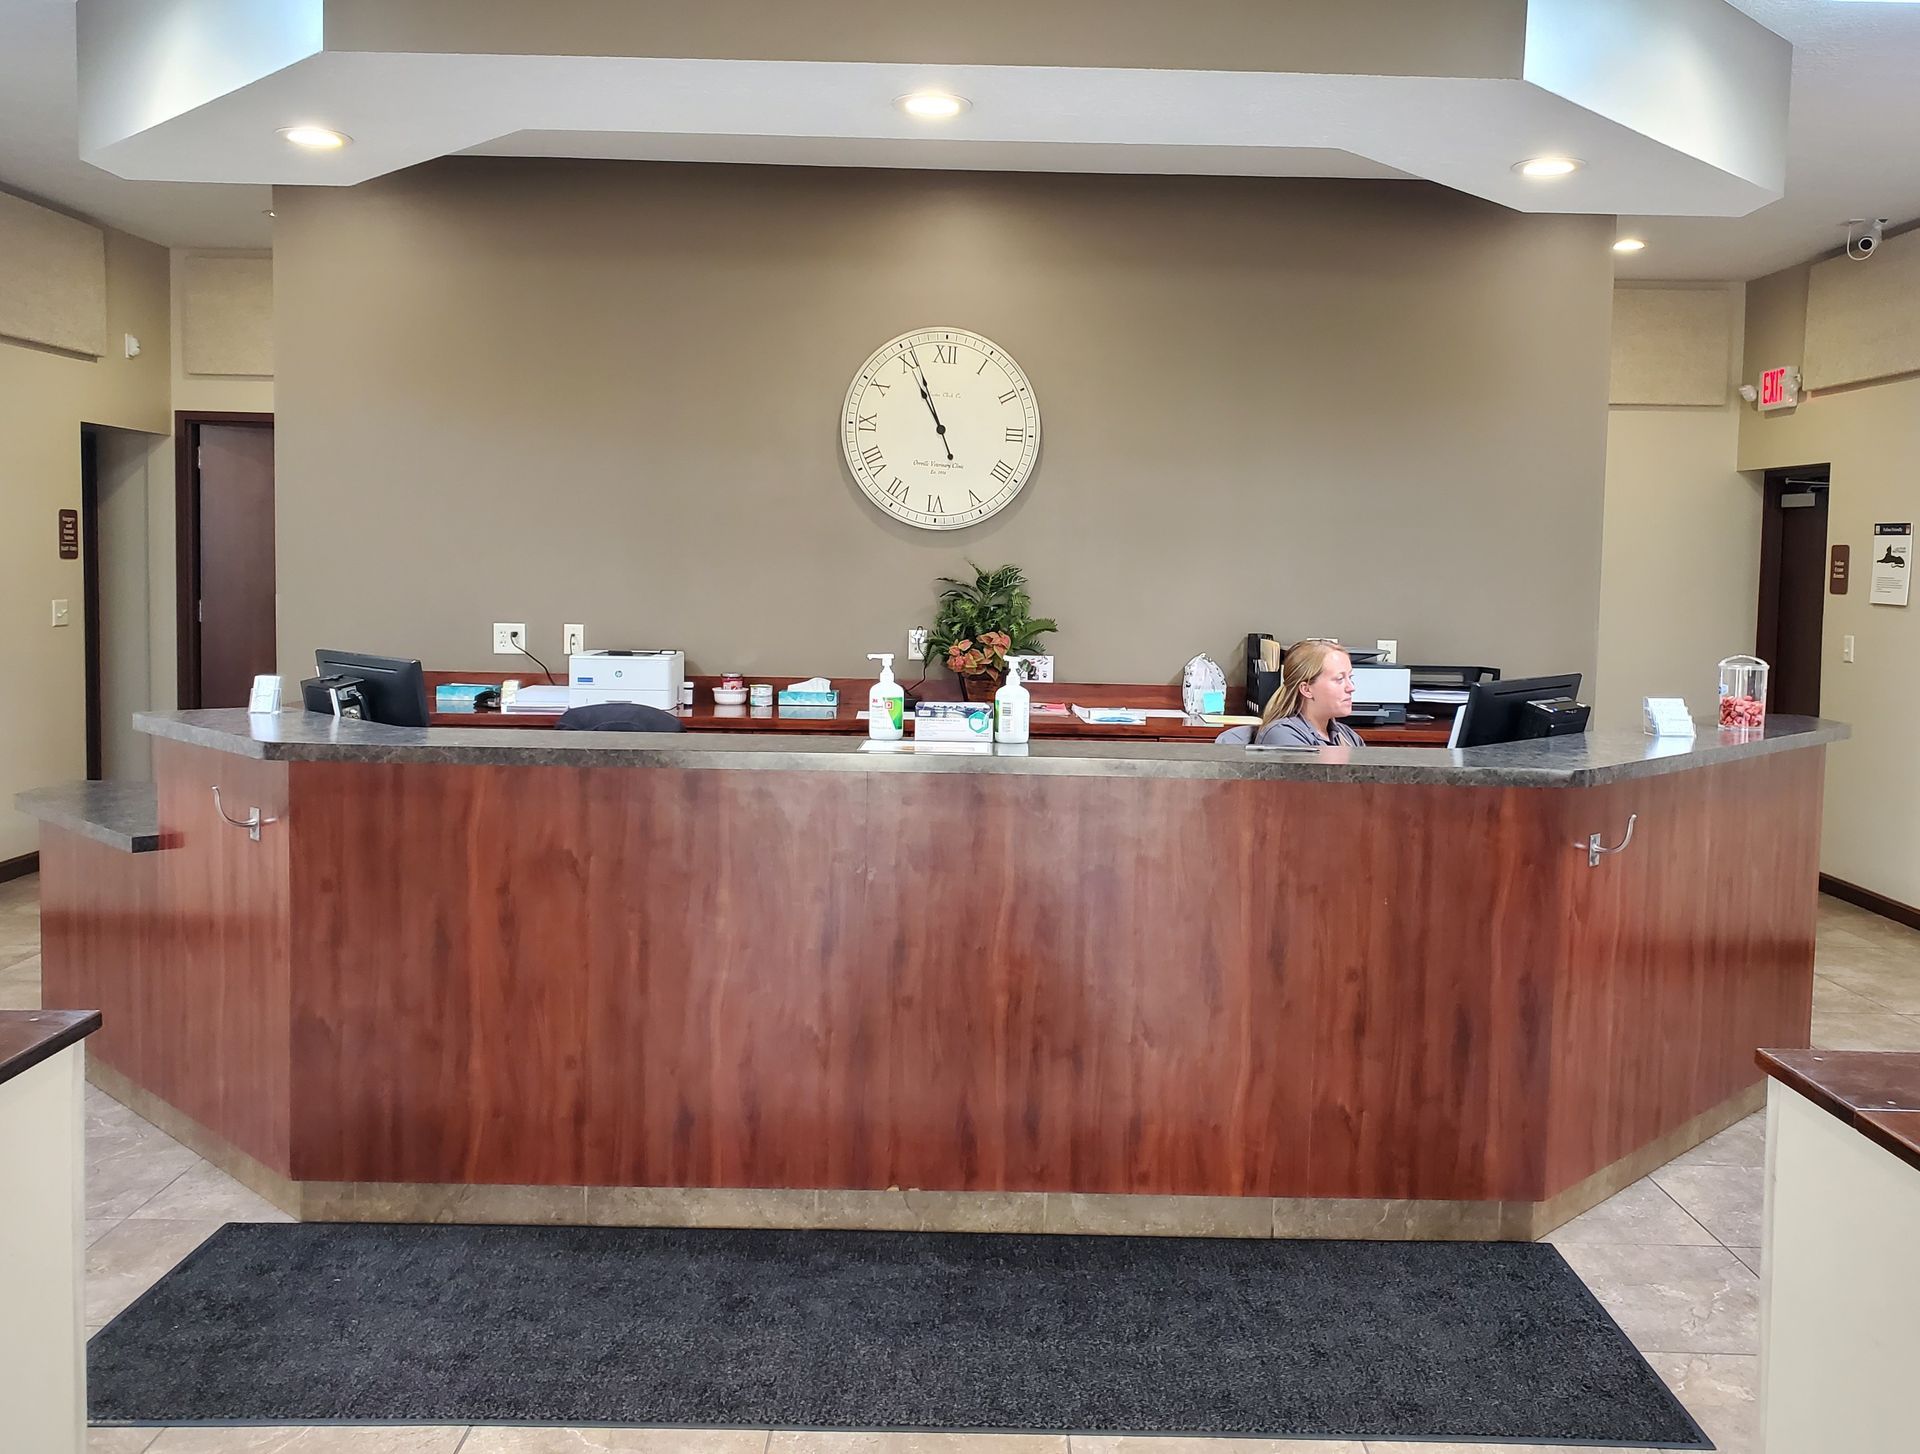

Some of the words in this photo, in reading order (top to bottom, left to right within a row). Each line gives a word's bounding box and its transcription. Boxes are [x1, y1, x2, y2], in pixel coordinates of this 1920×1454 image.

[932, 344, 957, 364] XII
[976, 358, 989, 375] I
[870, 379, 890, 397] X
[1763, 368, 1785, 404] EXIT
[998, 389, 1016, 405] II
[859, 413, 877, 432] IX
[1005, 427, 1024, 442] III
[862, 445, 887, 478] VIII
[886, 477, 910, 503] VII
[969, 489, 982, 507] V
[927, 494, 944, 513] VI
